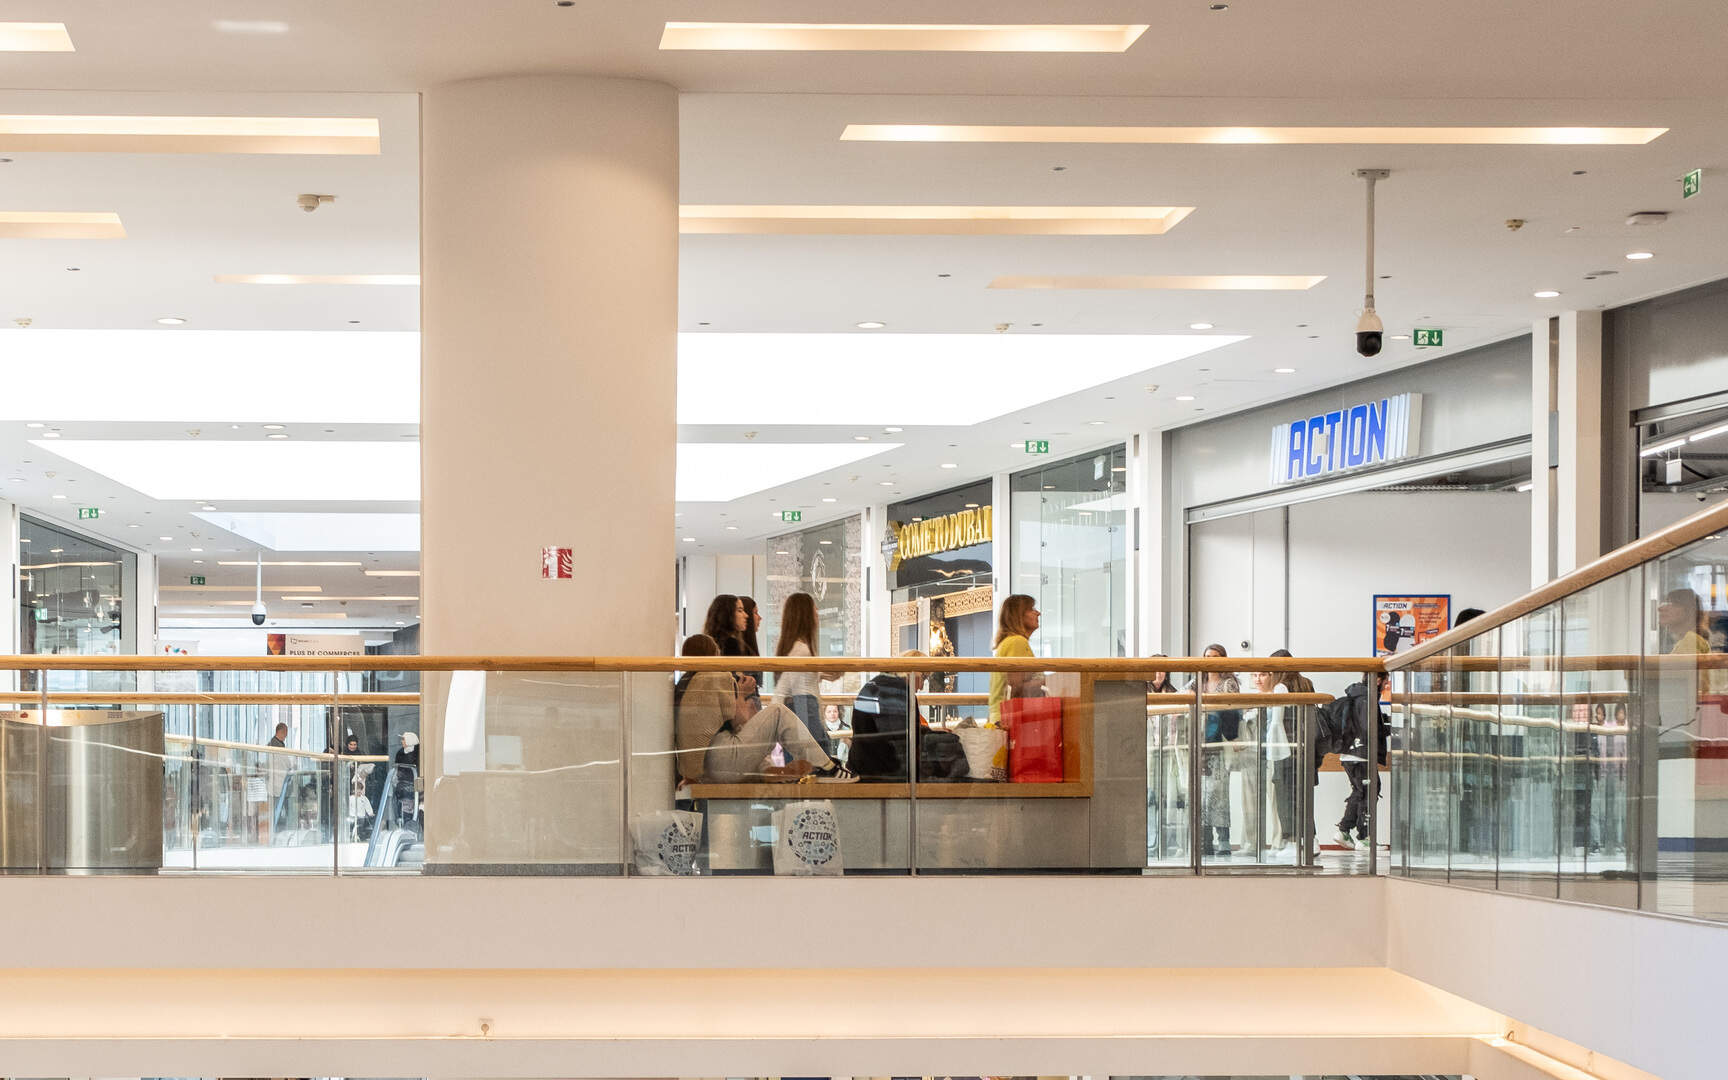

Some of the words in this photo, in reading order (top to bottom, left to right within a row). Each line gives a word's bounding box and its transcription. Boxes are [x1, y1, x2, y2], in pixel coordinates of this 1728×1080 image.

[1287, 399, 1389, 480] ACTION
[900, 519, 932, 560] COME
[933, 514, 949, 553] TO
[949, 505, 992, 550] DUBAI
